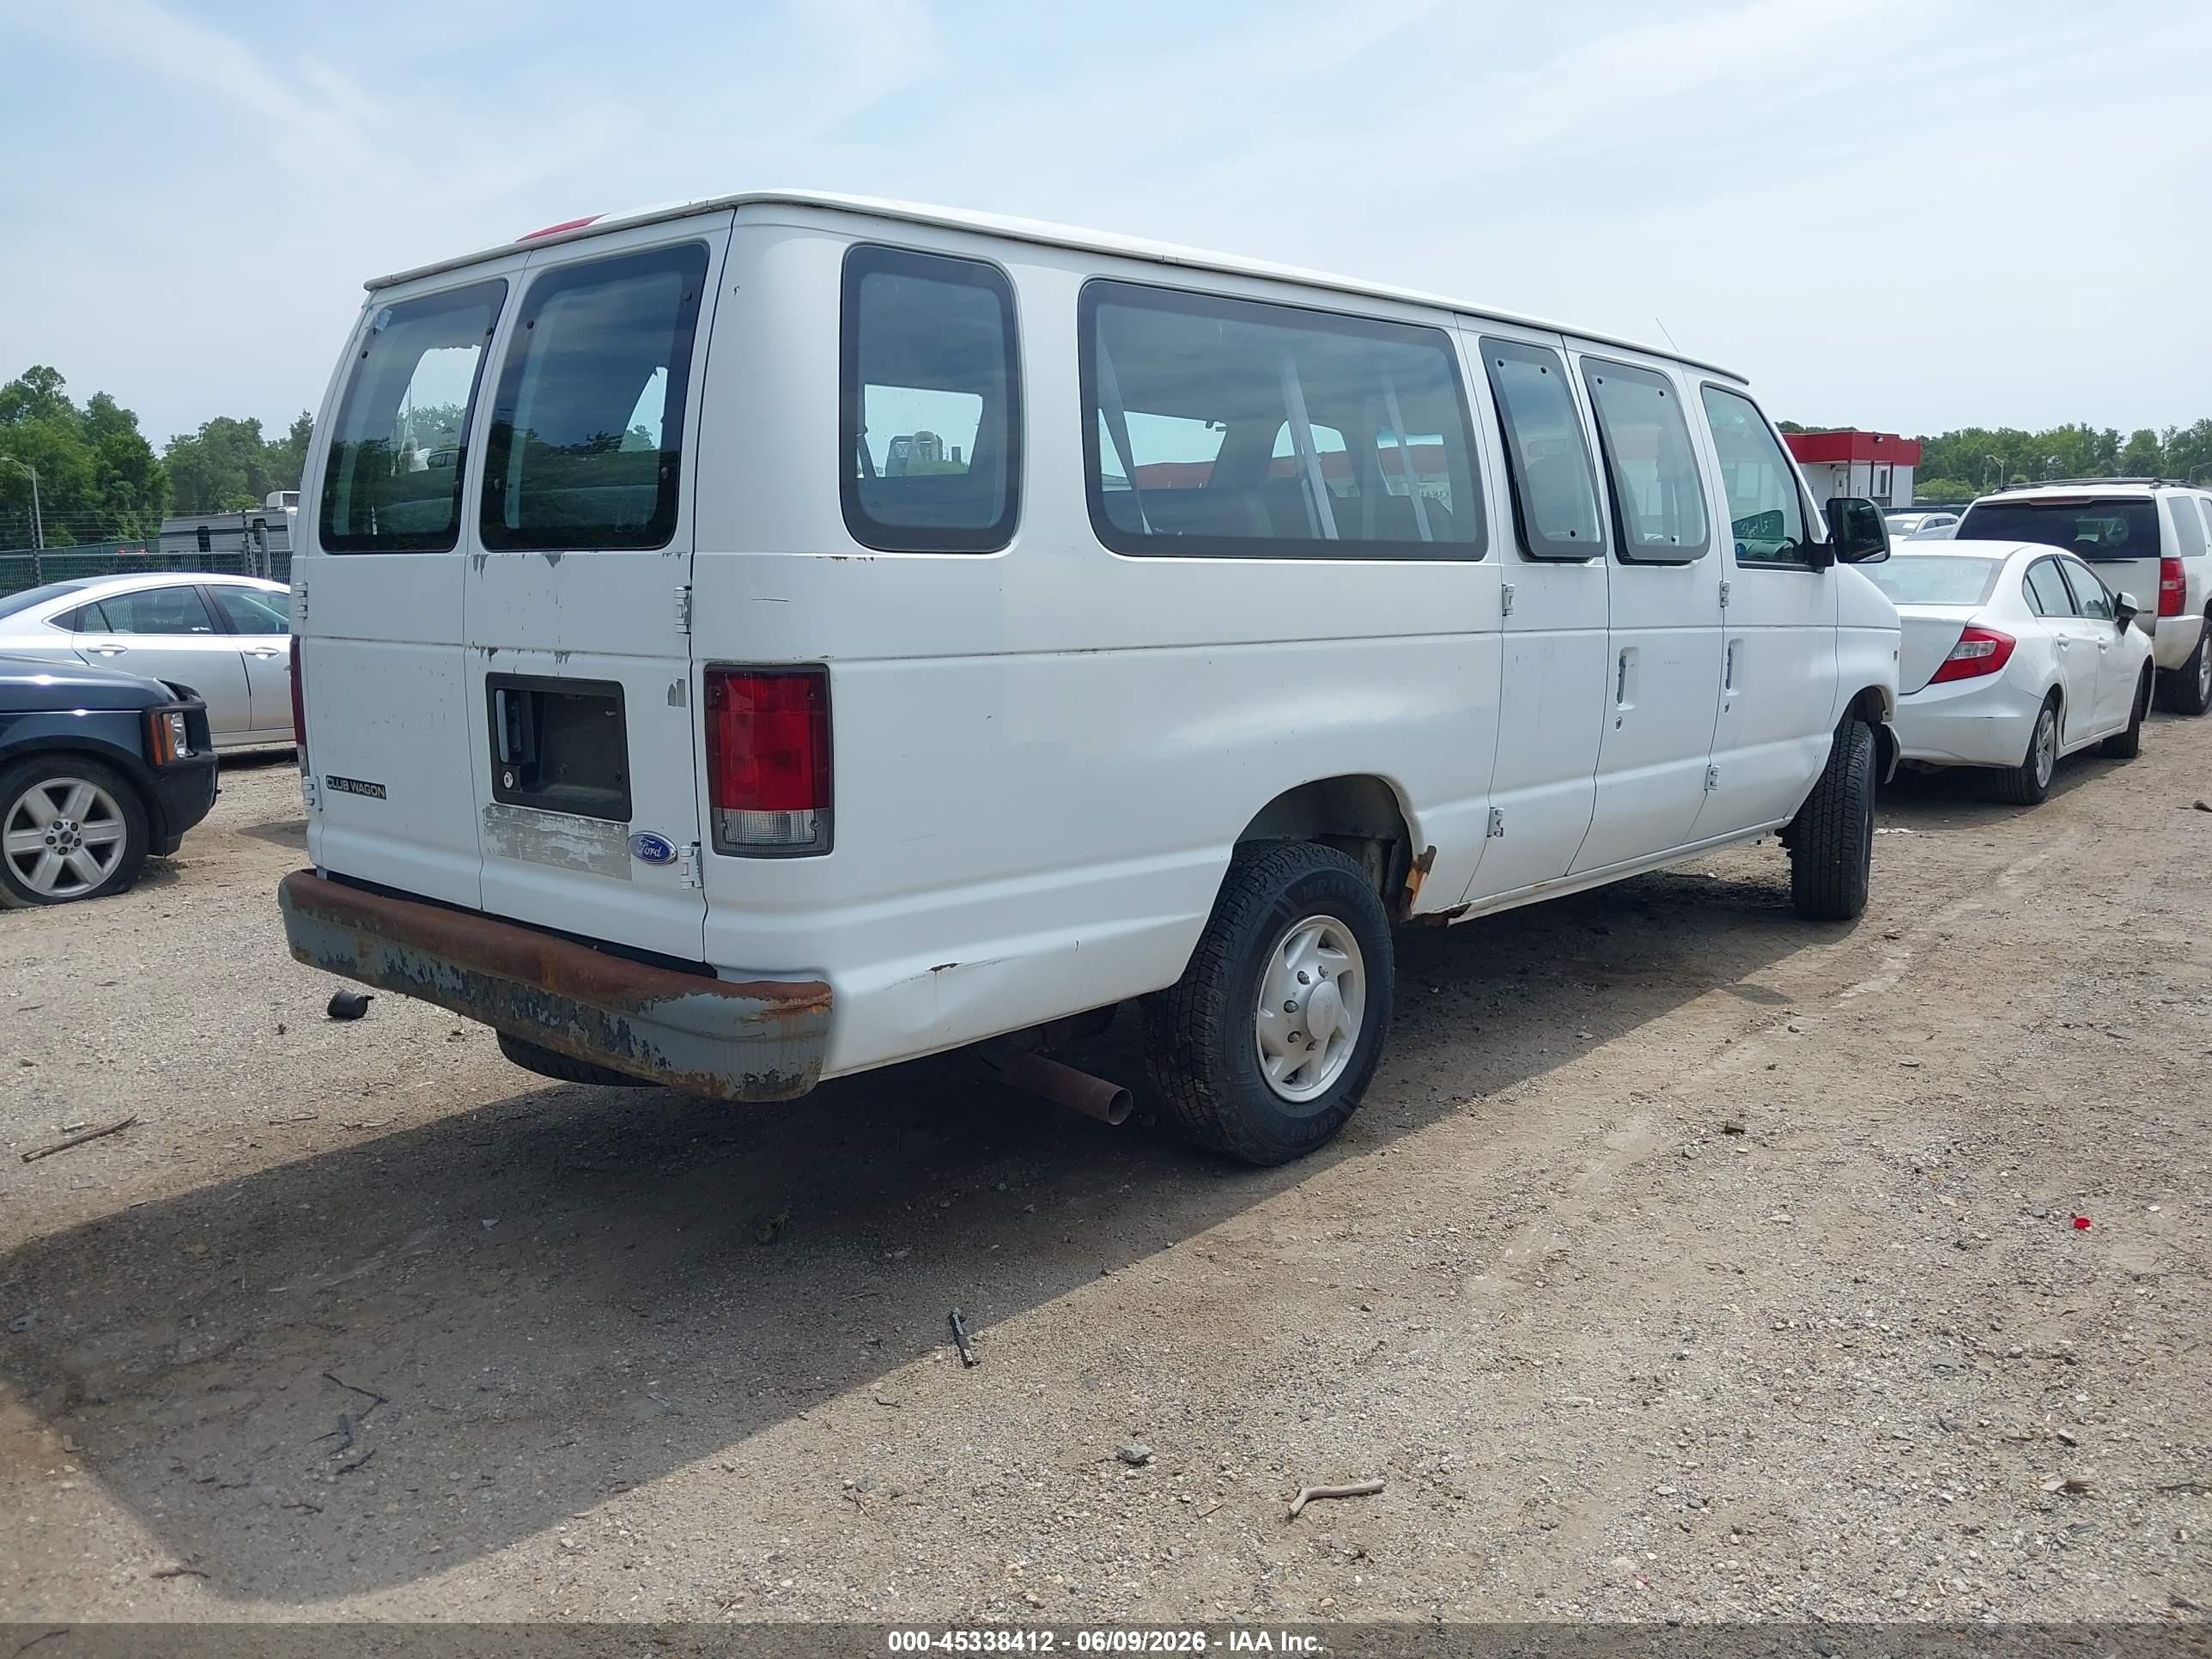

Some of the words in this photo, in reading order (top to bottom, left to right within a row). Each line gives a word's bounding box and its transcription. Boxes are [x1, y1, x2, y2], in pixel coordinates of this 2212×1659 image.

[327, 777, 349, 791] CLUB
[350, 781, 386, 797] WAGON
[636, 836, 662, 857] Ford
